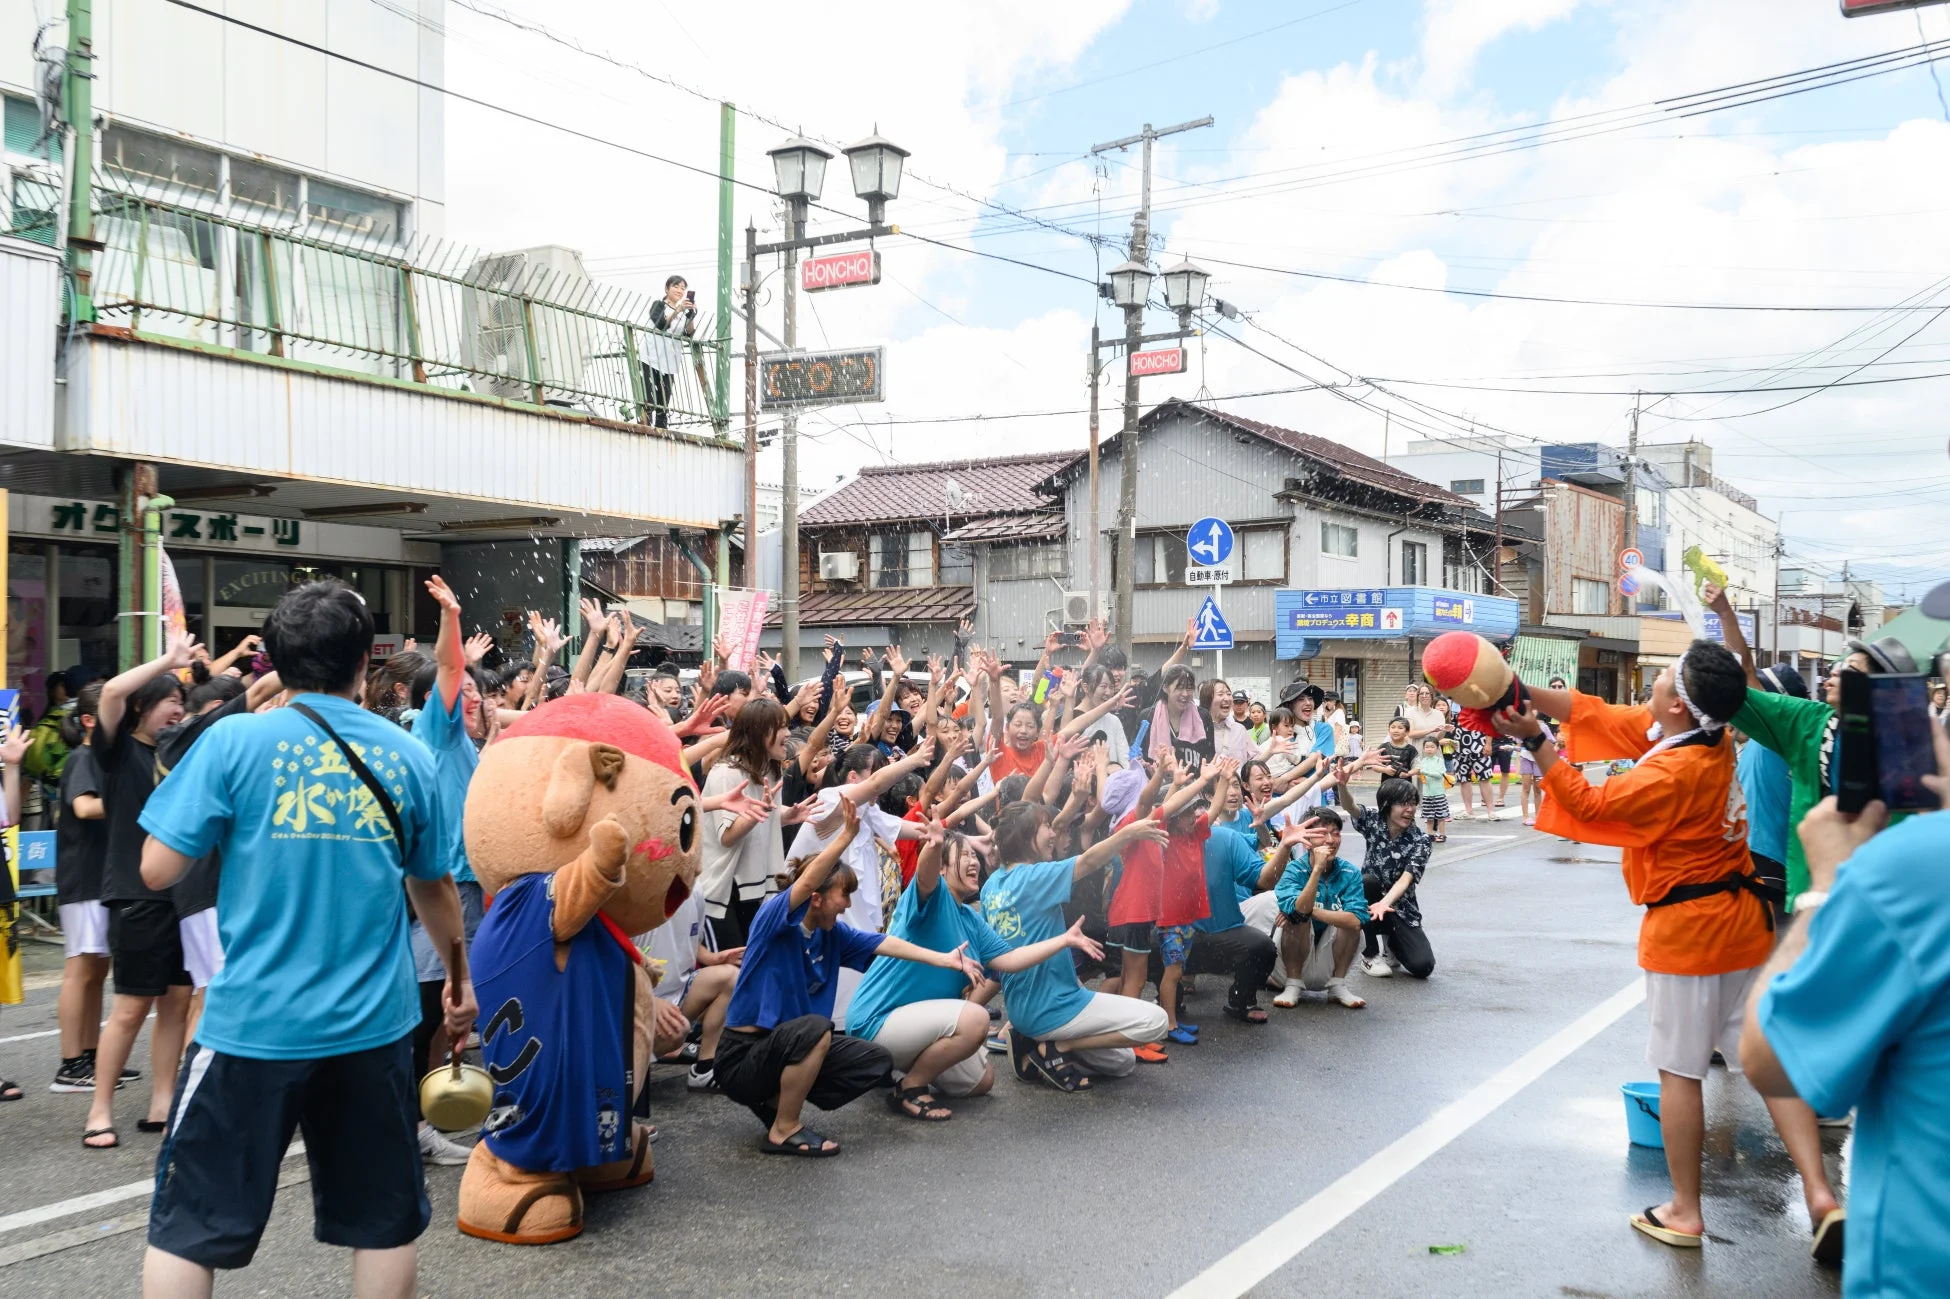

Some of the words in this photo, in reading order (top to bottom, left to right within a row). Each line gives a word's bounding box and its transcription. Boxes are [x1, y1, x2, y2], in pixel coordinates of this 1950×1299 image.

[805, 258, 868, 283] HONCHO
[1133, 353, 1178, 370] HONCHO
[53, 502, 299, 545] オクスポーツ
[1625, 555, 1638, 565] 40
[1189, 570, 1229, 581] 自動車・原付
[219, 570, 301, 600] EXCITING
[1320, 592, 1383, 605] 市立図書館
[1345, 613, 1374, 627] 幸商
